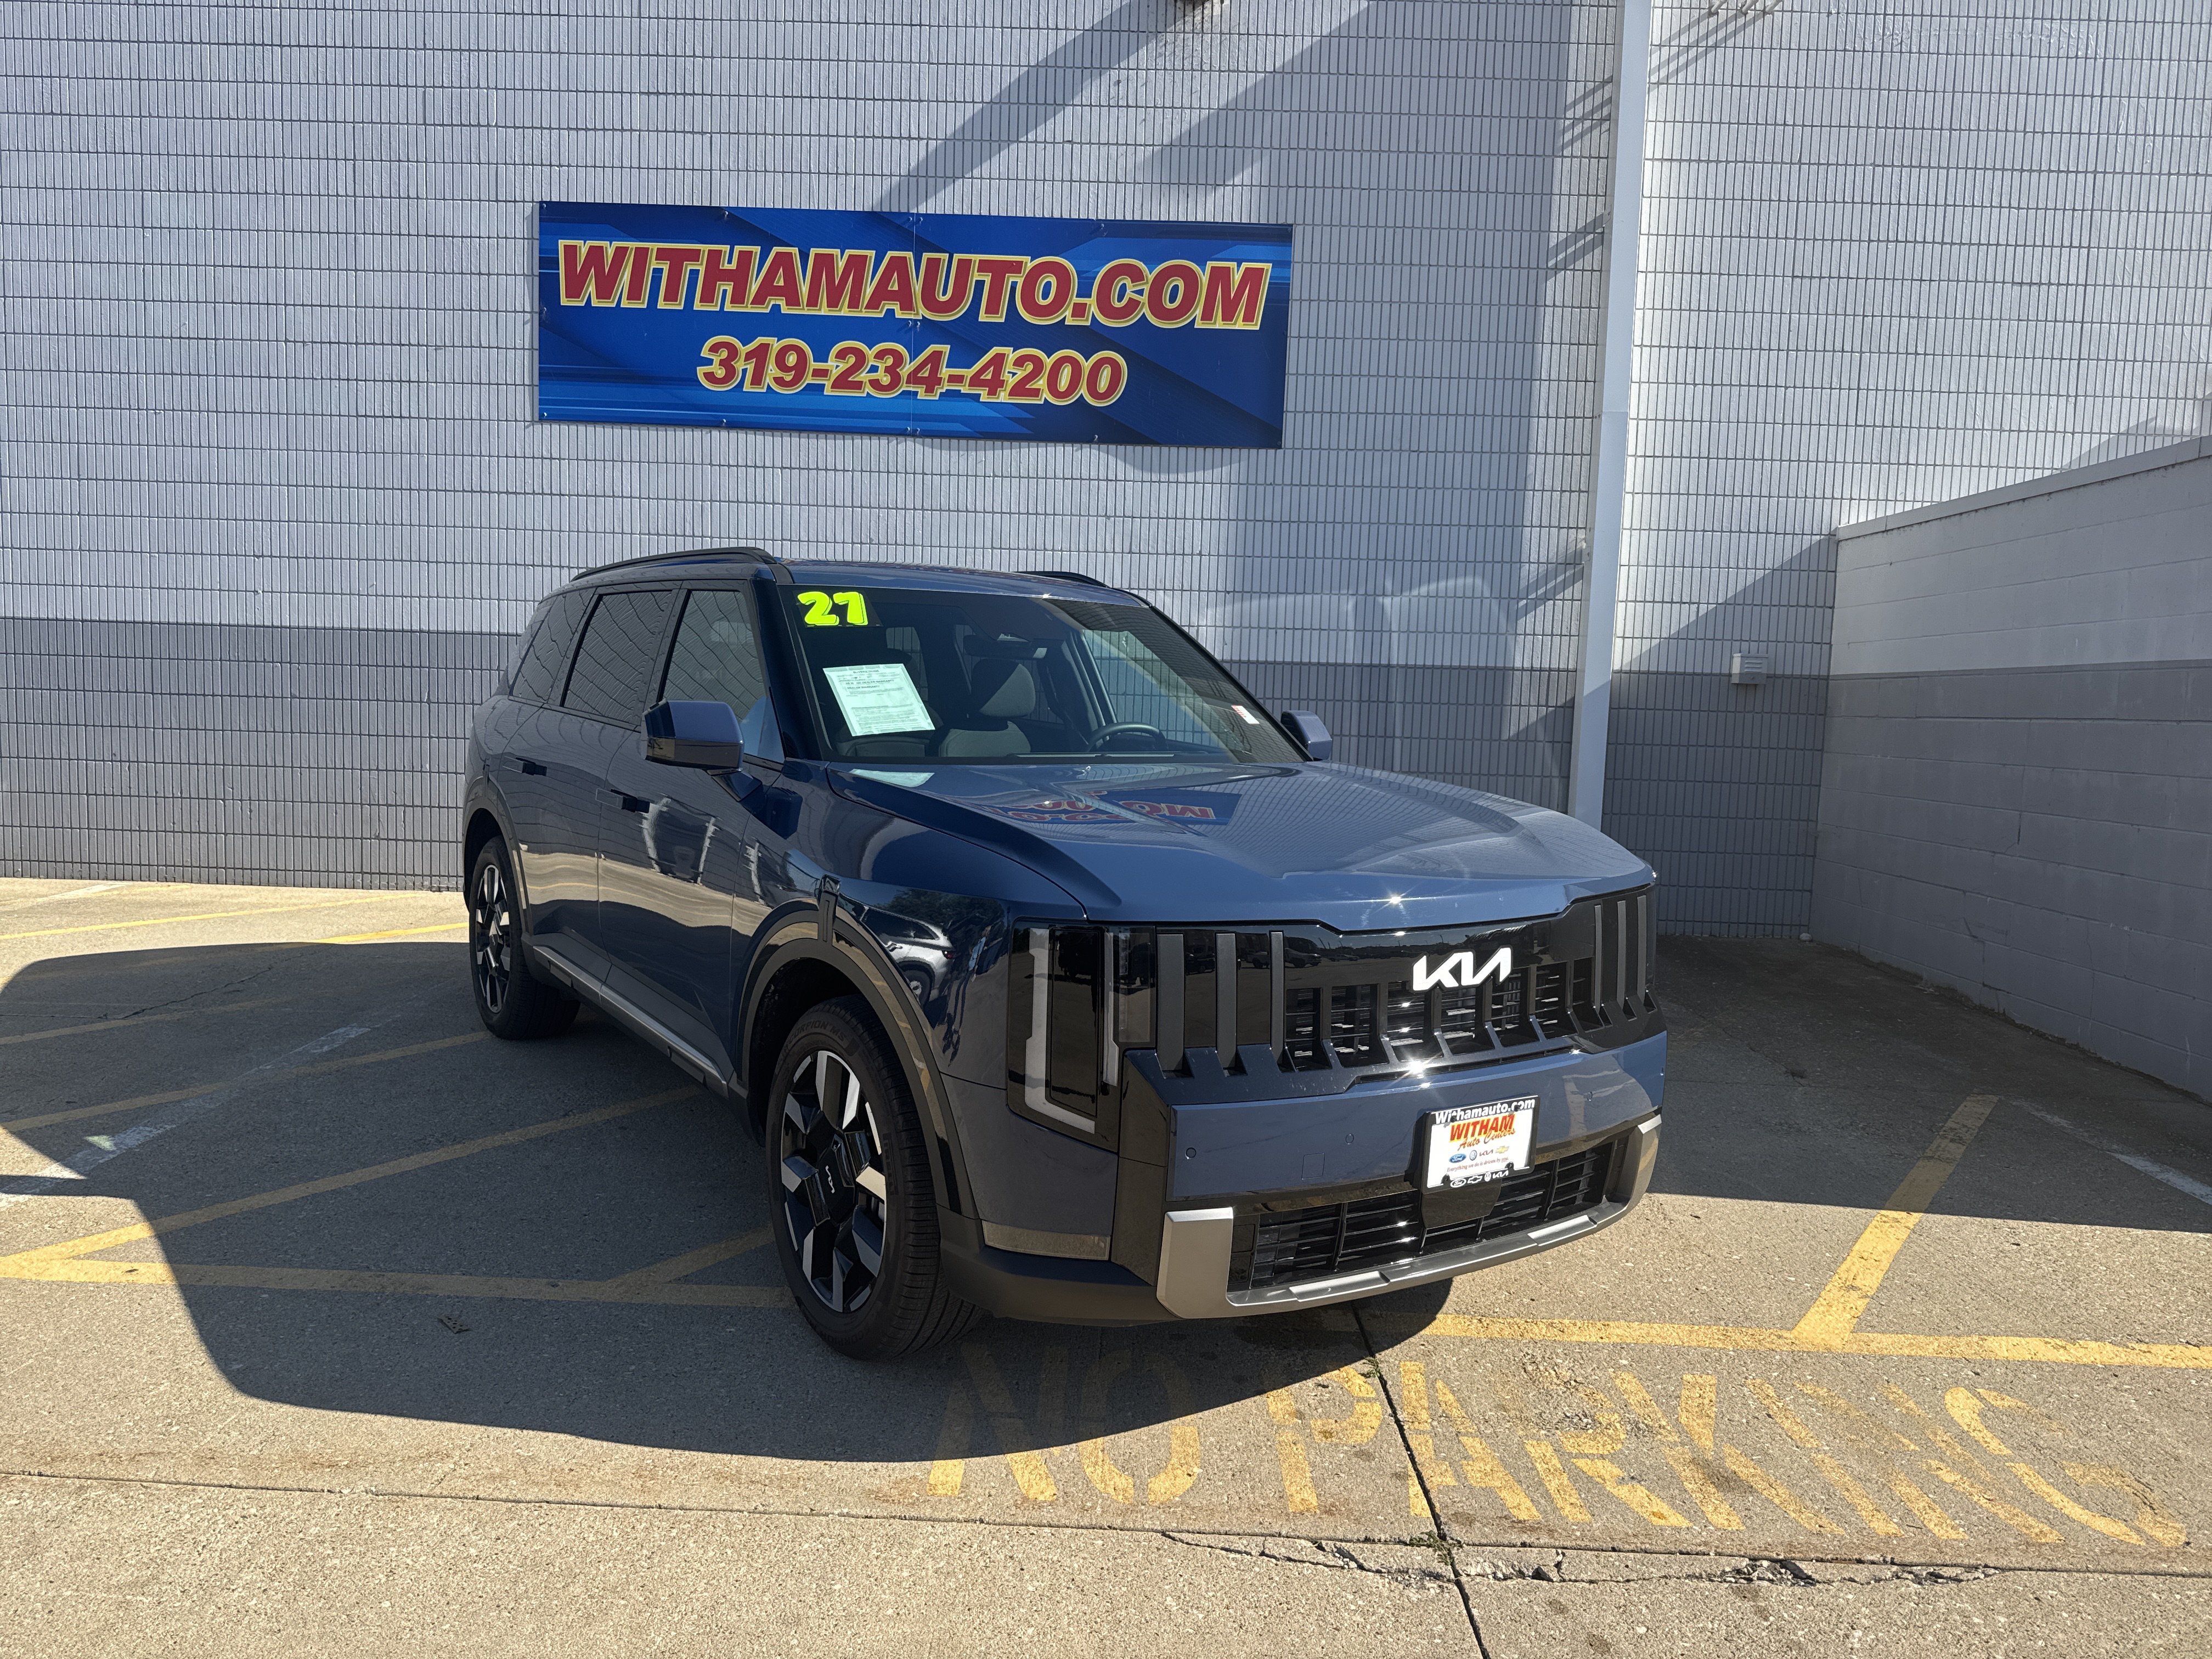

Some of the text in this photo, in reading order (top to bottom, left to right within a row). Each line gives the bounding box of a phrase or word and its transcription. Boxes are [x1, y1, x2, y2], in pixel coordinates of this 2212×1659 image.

[558, 240, 1272, 330] WITHAMAUTO.COM
[697, 335, 1128, 407] 319-234-4200
[797, 591, 868, 625] 27
[1413, 947, 1511, 991] KIA
[1450, 1114, 1516, 1141] WITHAM
[1458, 1127, 1515, 1151] Auto Centers
[1492, 1170, 1509, 1178] KIA
[926, 1342, 2188, 1546] NO PARKING
